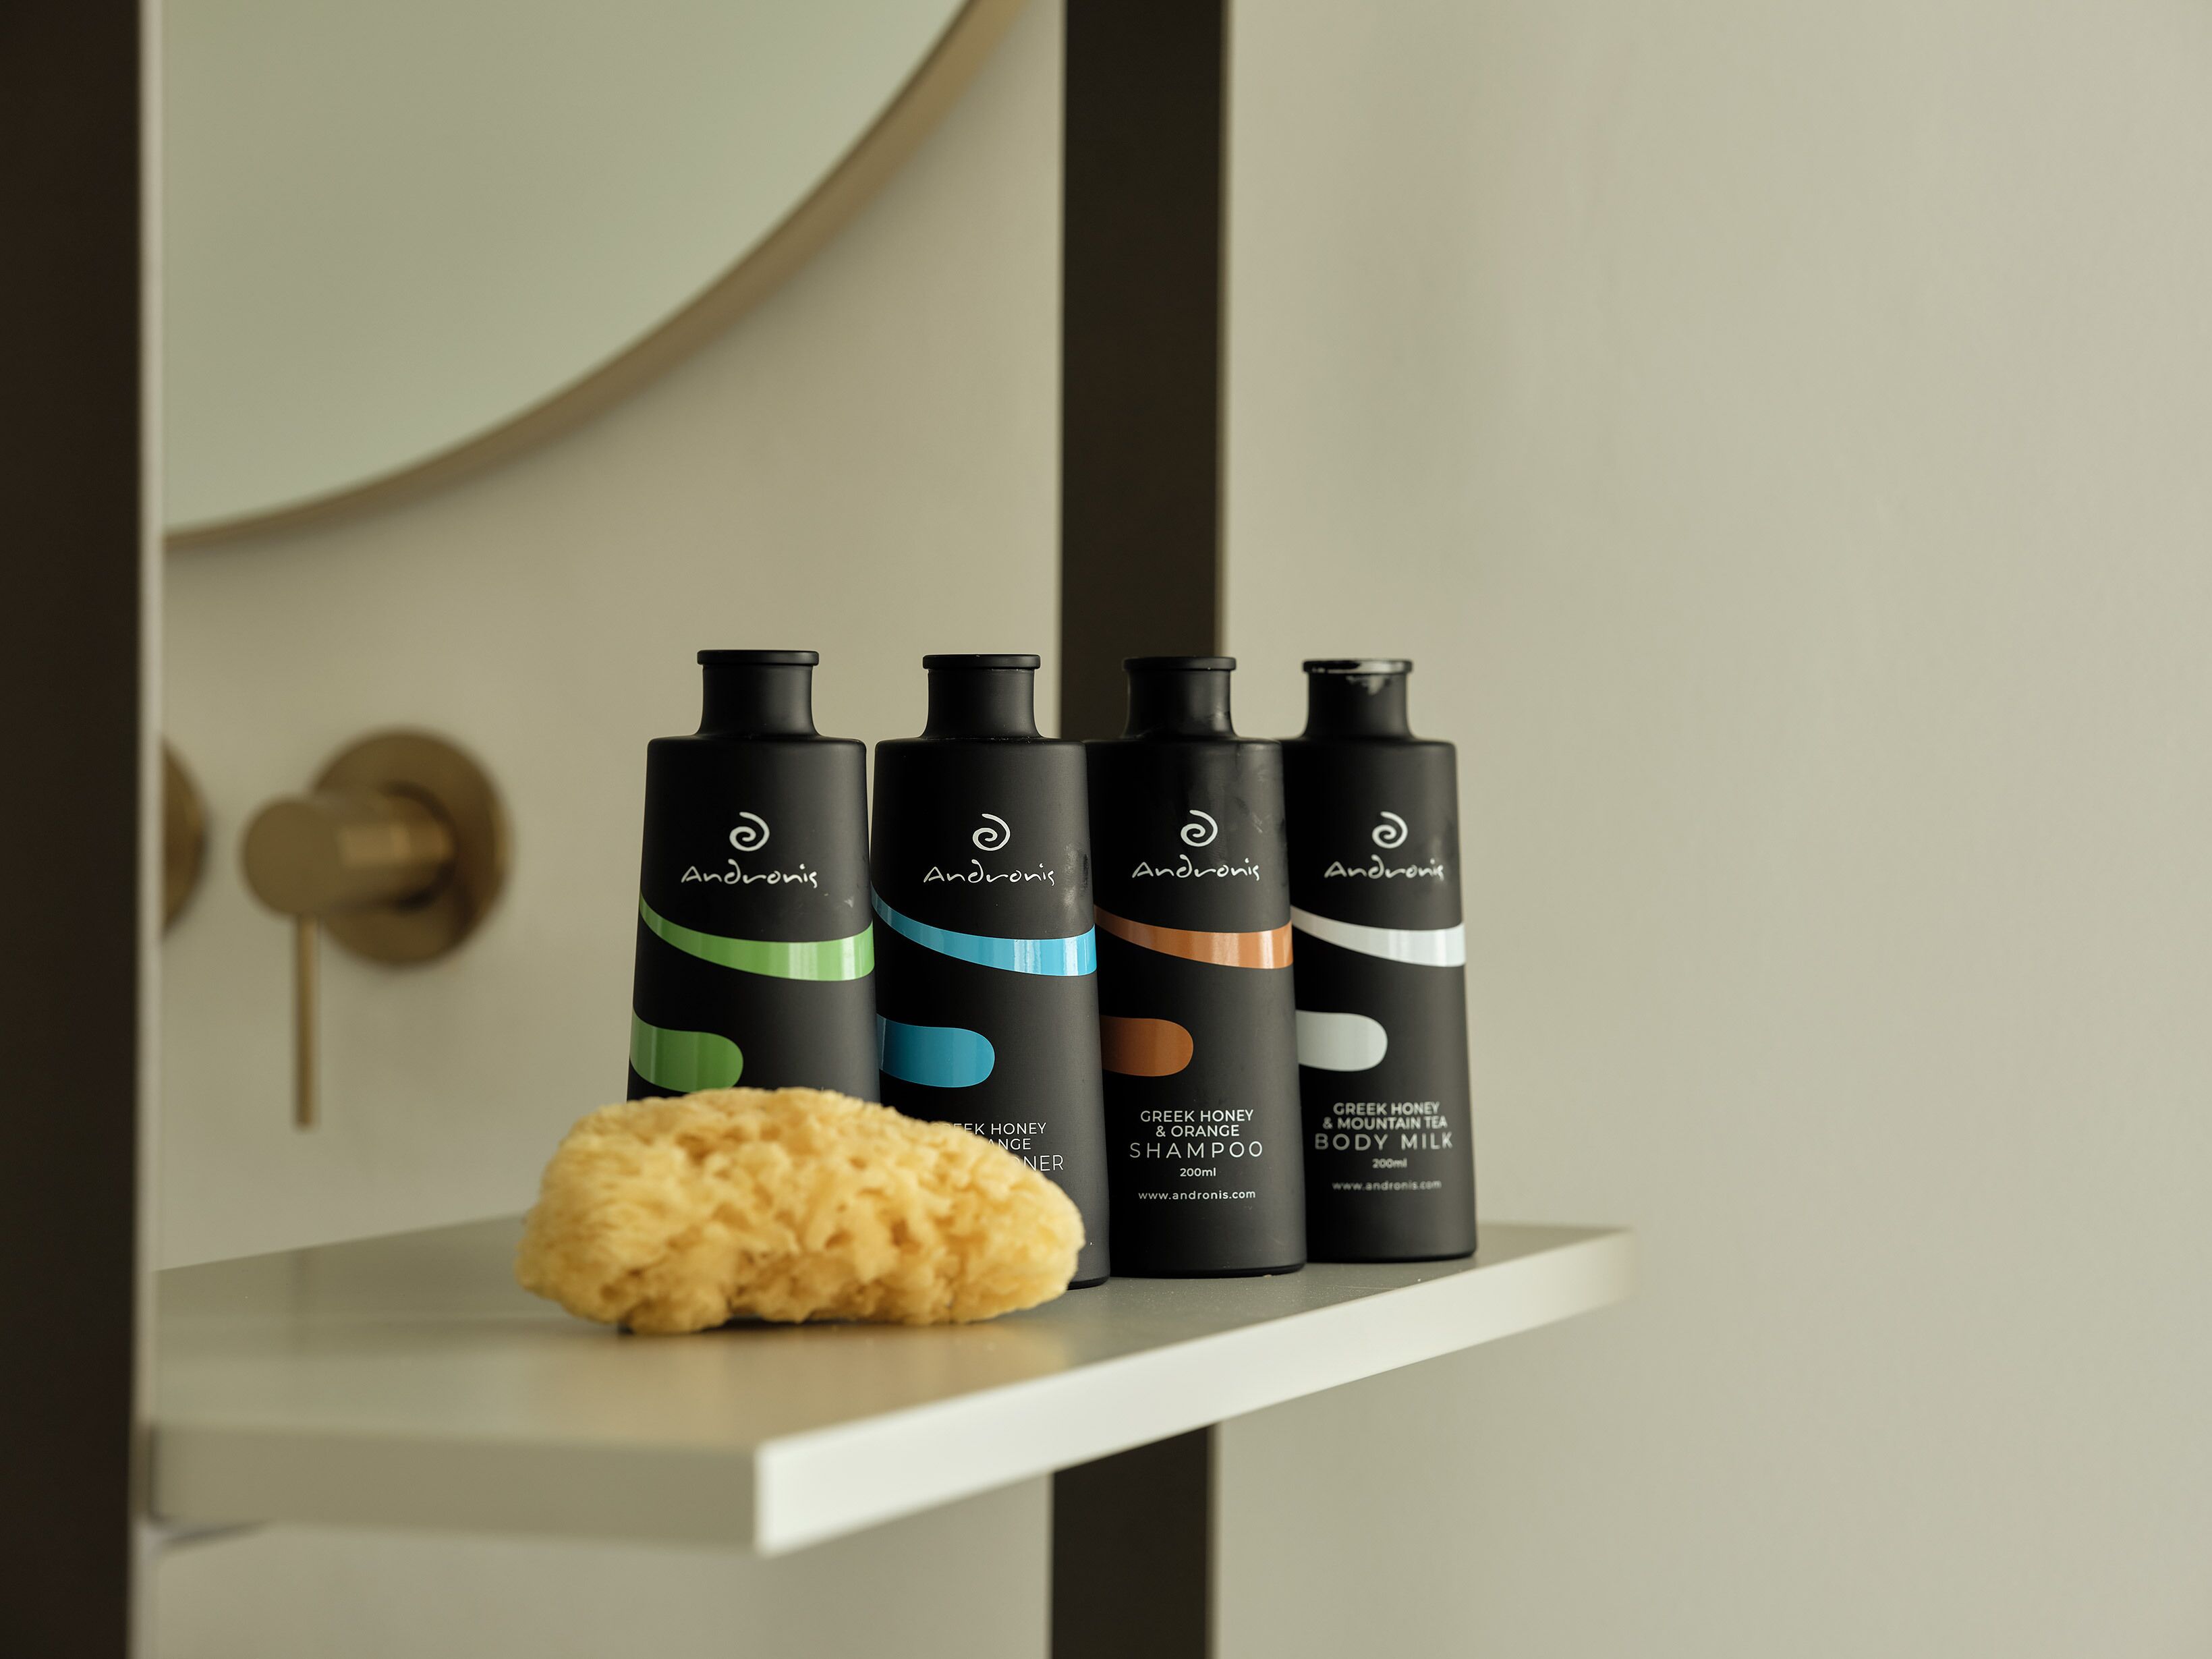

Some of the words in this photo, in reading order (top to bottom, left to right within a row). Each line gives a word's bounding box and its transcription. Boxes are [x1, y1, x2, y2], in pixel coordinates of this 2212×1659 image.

[681, 858, 818, 889] Andronis
[923, 859, 1055, 887] Andronis
[1131, 853, 1260, 881] Andronis
[1324, 853, 1444, 882] Andronis
[1140, 1110, 1195, 1123] GREEK
[1200, 1109, 1254, 1123] HONEY
[1332, 1102, 1388, 1116] GREEK
[1390, 1102, 1440, 1116] HONEY
[991, 1122, 1047, 1135] HONEY
[1322, 1117, 1334, 1129] &
[1337, 1117, 1421, 1129] MOUNTAIN
[1424, 1116, 1448, 1129] TEA
[1155, 1125, 1166, 1137] &
[1170, 1125, 1240, 1137] ORANGE
[1314, 1133, 1388, 1151] BODY
[1400, 1131, 1453, 1150] MILK
[1129, 1141, 1263, 1159] SHAMPOO
[1372, 1158, 1408, 1169] 200ml
[1179, 1167, 1216, 1177] 200ml
[1332, 1180, 1442, 1191] www.andronis.com
[1138, 1189, 1256, 1200] www.andronis.com
